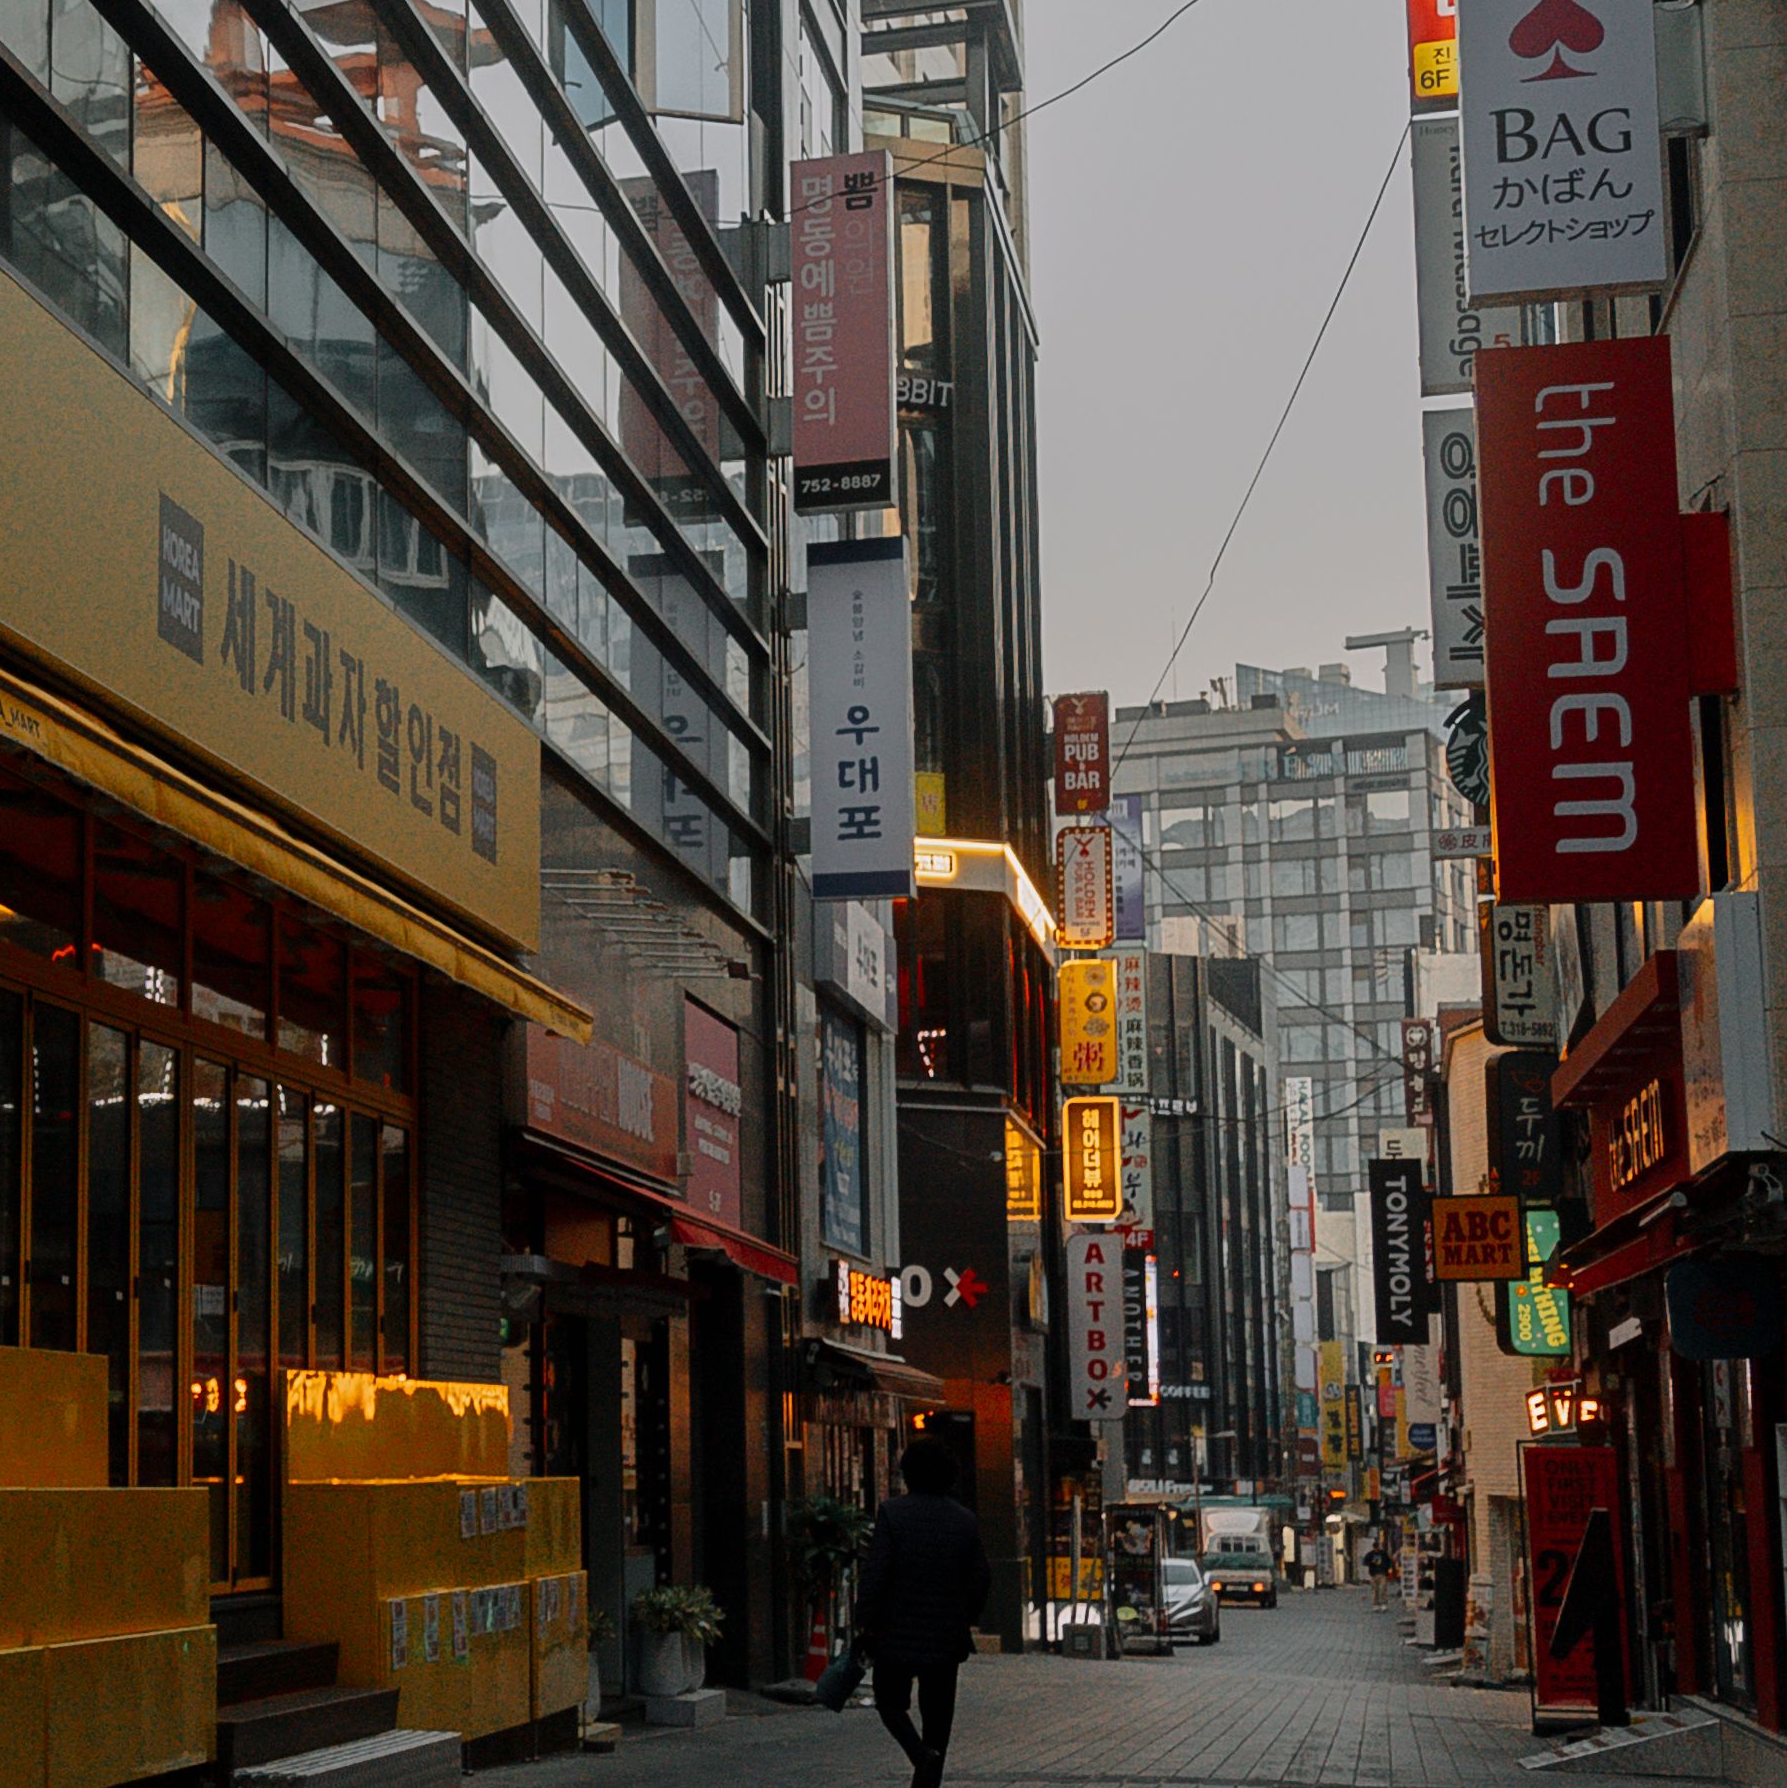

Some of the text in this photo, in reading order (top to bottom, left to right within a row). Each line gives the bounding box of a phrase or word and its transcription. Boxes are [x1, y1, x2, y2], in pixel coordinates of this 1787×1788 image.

[1489, 107, 1633, 164] BAG
[1492, 168, 1634, 211] かばん
[1474, 208, 1655, 249] セレクトショップ
[800, 473, 882, 495] 752-8887
[163, 526, 201, 587] KOREA
[162, 576, 201, 635] MART
[1534, 381, 1639, 854] the SAEM
[835, 704, 882, 841] 우대포
[1064, 742, 1100, 763] PUB
[1064, 770, 1101, 791] BAR
[1084, 860, 1096, 919] HOLDEM
[1126, 1231, 1149, 1247] 4F
[1384, 1174, 1413, 1328] TONYMOLY
[1442, 1210, 1511, 1243] ABC
[1443, 1242, 1512, 1266] MART
[1084, 1242, 1111, 1410] ARTBOX
